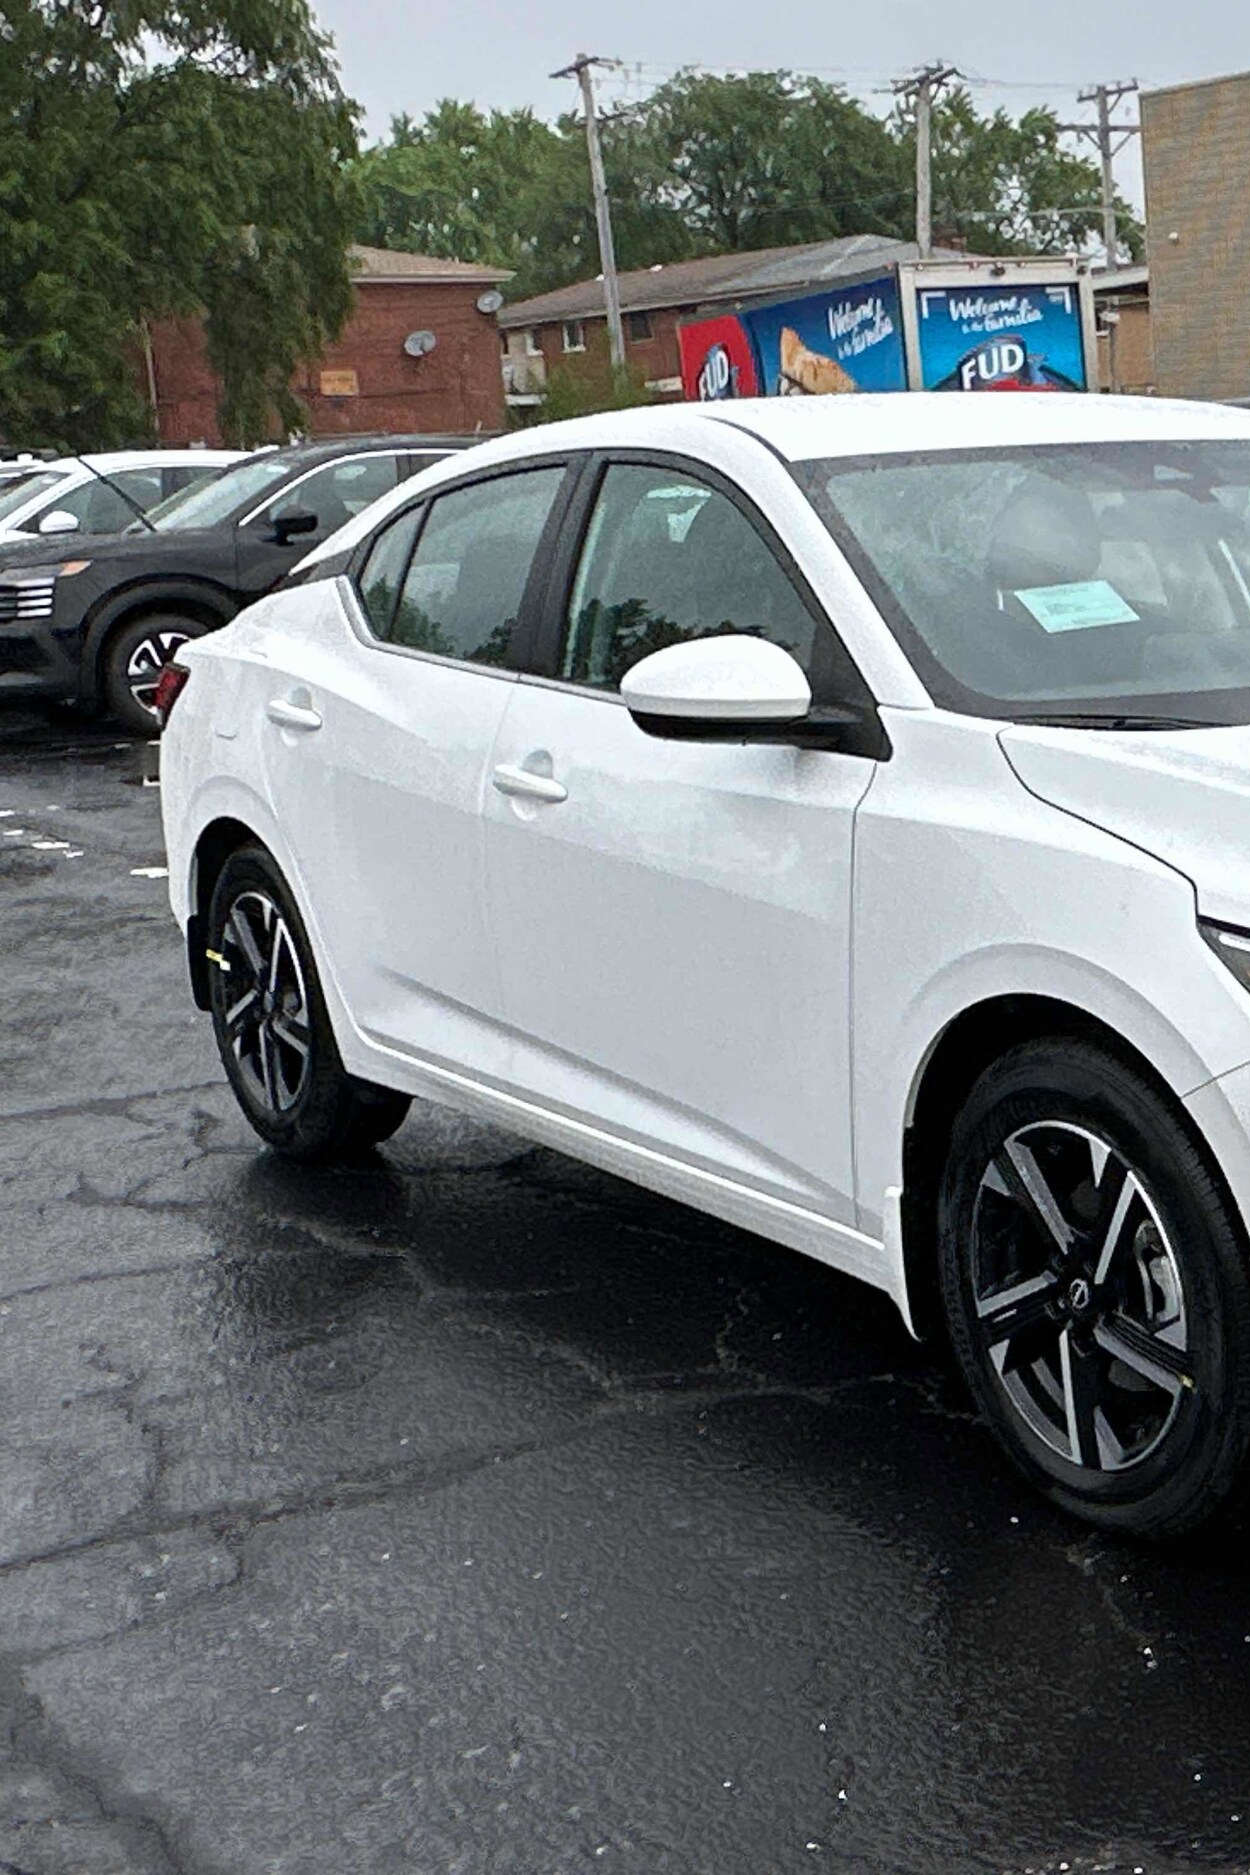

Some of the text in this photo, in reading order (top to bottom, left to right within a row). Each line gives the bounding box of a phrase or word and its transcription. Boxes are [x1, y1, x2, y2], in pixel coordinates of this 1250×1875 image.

[949, 297, 1018, 321] Welcome
[698, 349, 729, 398] FUD
[961, 343, 1025, 391] FUD
